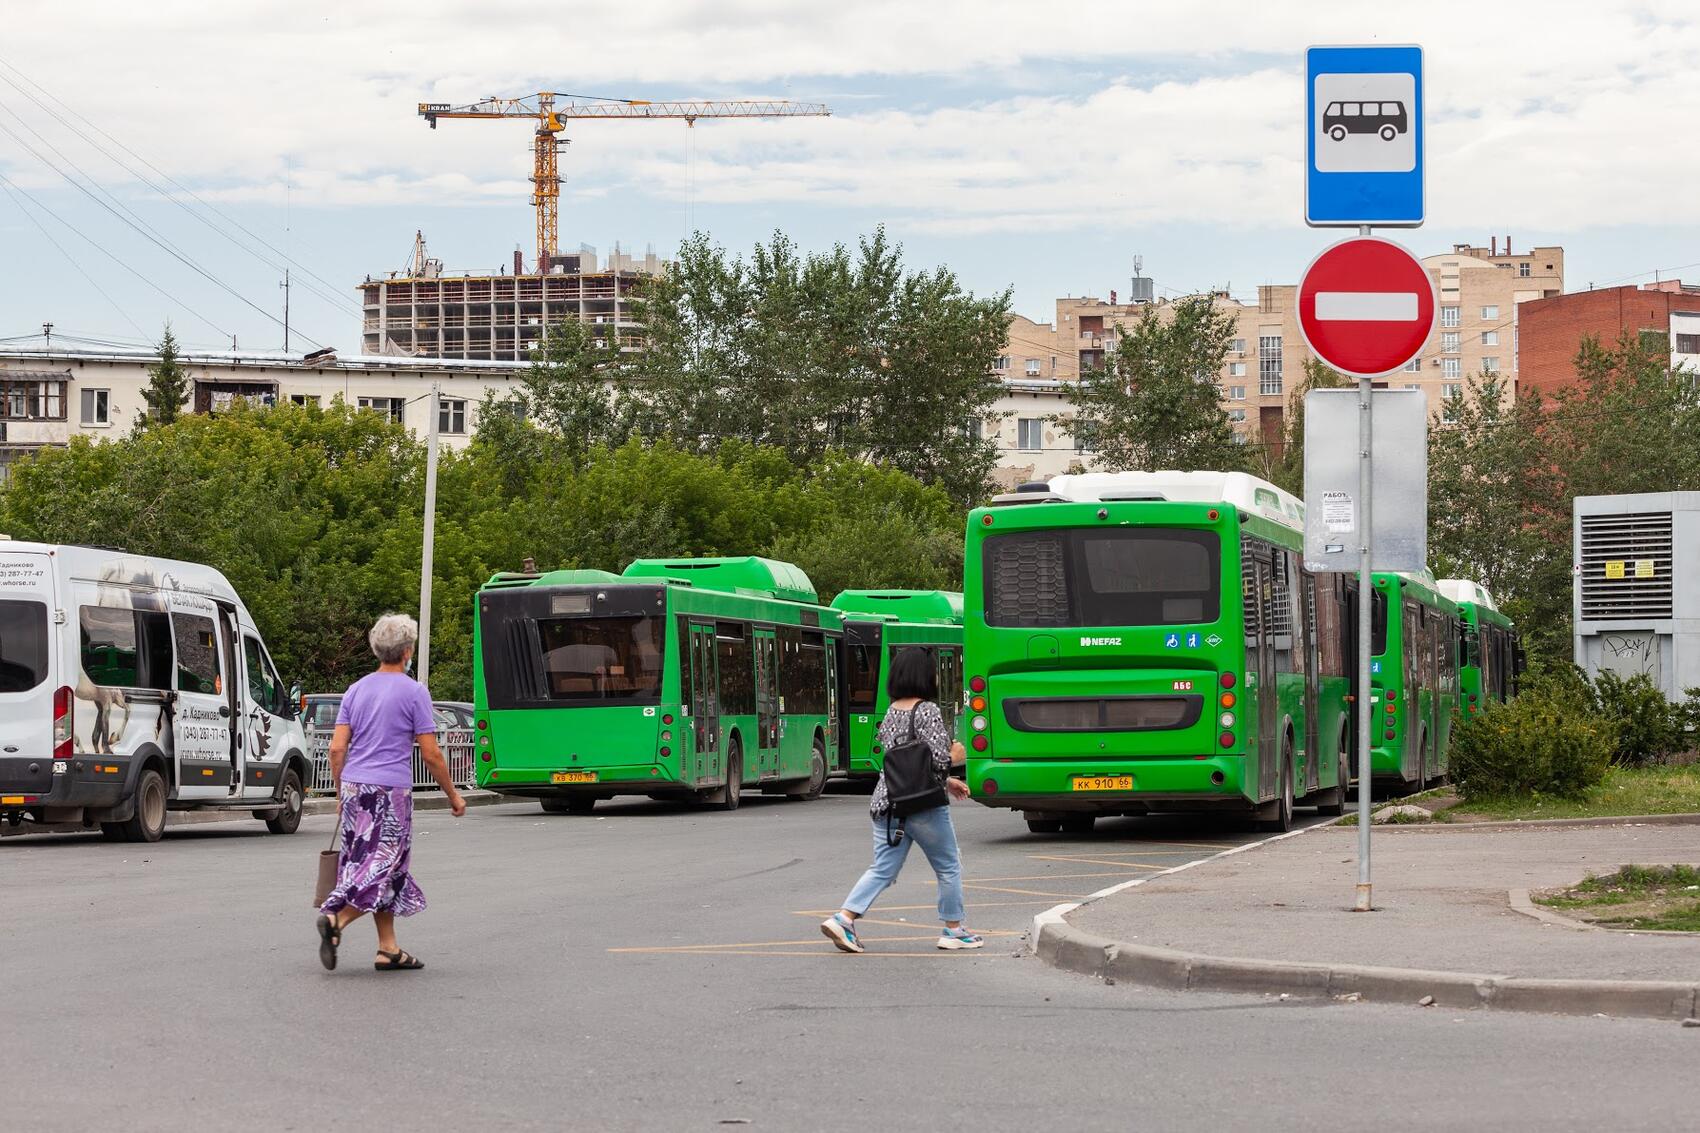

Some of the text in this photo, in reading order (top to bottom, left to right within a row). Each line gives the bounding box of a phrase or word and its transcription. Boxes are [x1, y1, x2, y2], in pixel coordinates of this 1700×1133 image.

[1091, 637, 1122, 646] NEFAZ
[1094, 778, 1114, 789] 910
[1119, 777, 1129, 786] 66
